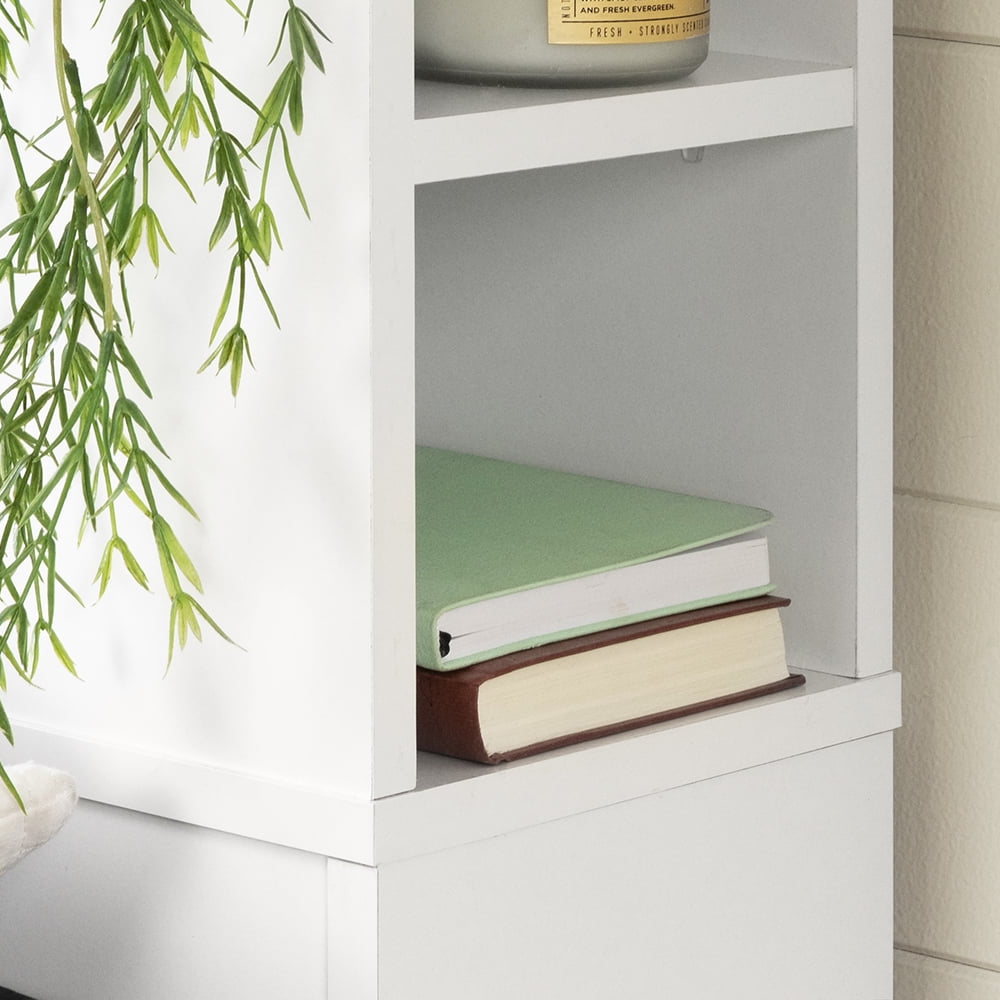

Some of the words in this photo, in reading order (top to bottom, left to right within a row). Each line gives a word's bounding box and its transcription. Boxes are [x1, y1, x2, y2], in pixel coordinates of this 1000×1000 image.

[602, 6, 630, 14] FRESH
[632, 3, 675, 13] EVERGREEN.
[589, 26, 622, 38] FRESH
[639, 23, 679, 37] STRONGLY
